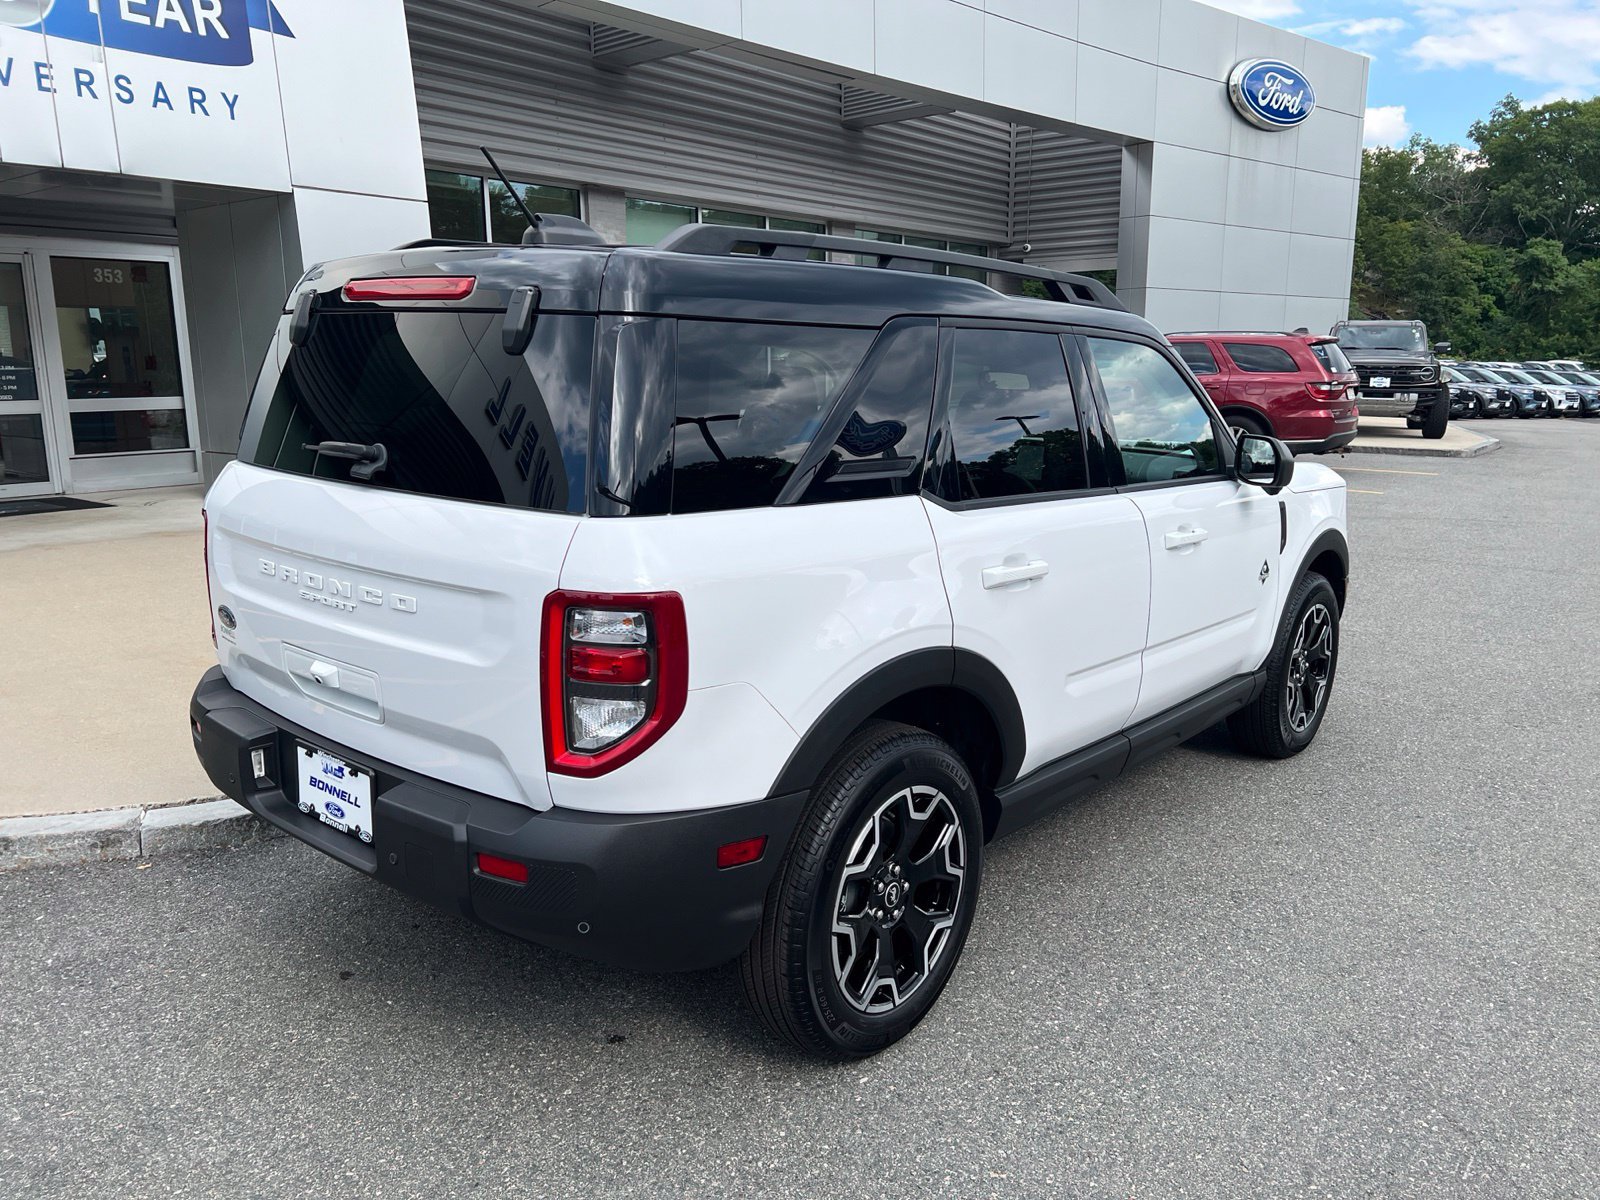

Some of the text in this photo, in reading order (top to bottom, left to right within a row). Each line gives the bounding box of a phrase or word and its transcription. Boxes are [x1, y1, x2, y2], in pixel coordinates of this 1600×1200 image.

[89, 0, 230, 39] EAR
[1258, 71, 1304, 115] Ford
[93, 267, 124, 284] 353
[259, 558, 418, 614] BRONCO
[298, 589, 358, 613] SPORT
[309, 775, 361, 809] BONNELL
[319, 813, 348, 833] Bonnell
